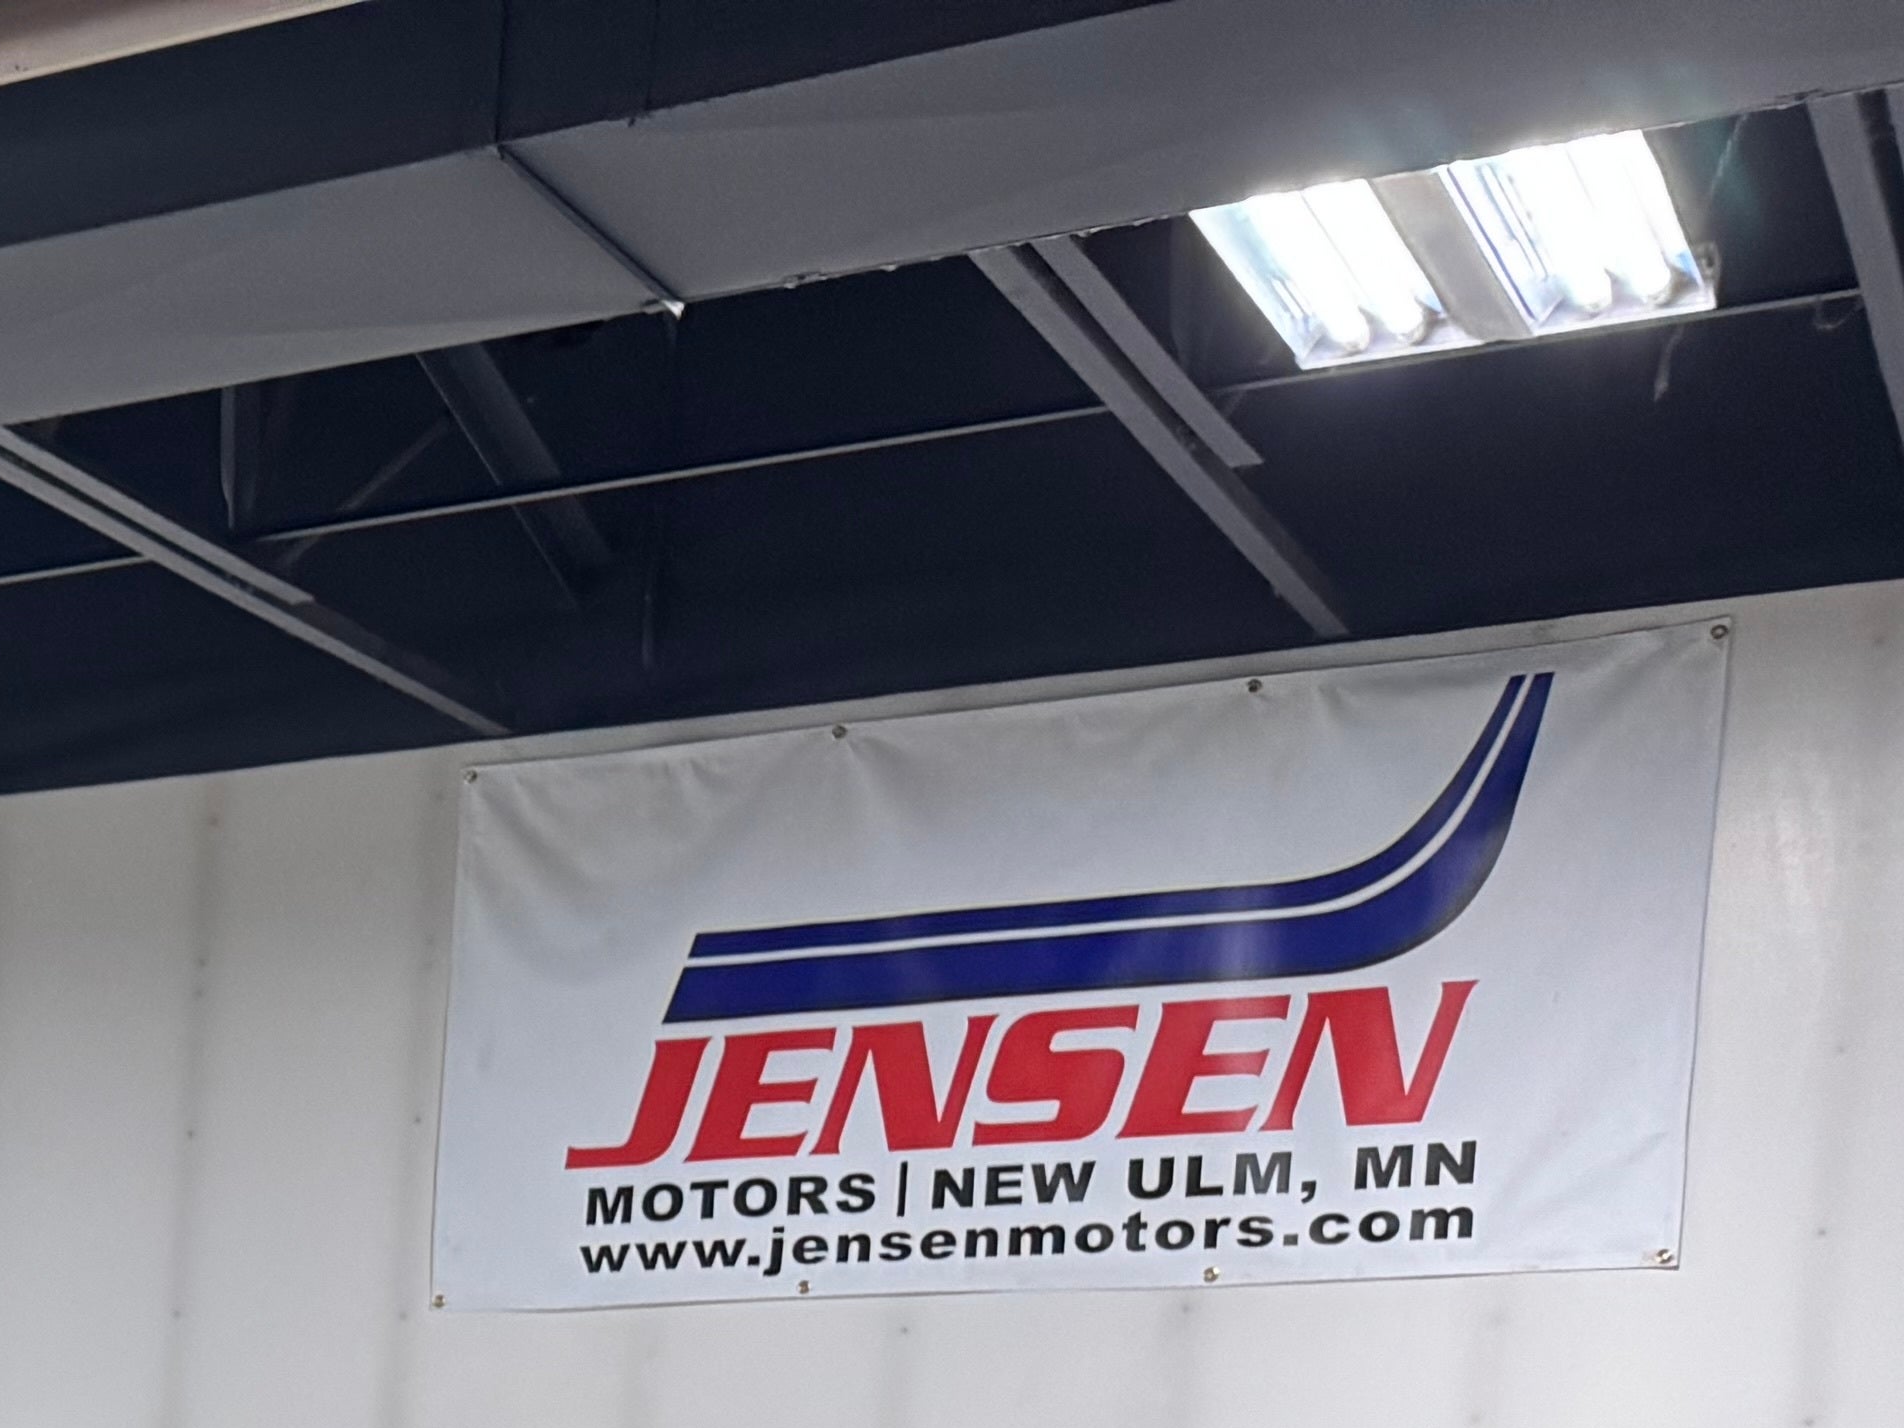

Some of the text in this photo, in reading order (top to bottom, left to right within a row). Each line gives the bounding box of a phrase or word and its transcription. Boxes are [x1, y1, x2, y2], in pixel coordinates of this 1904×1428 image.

[566, 980, 1477, 1170] JENSEN
[585, 1172, 877, 1227] MOTORS
[930, 1160, 1097, 1210] NEW
[1127, 1150, 1319, 1203] ULM,
[1353, 1139, 1478, 1191] MN
[579, 1205, 1475, 1278] www.jensenmotors.com
